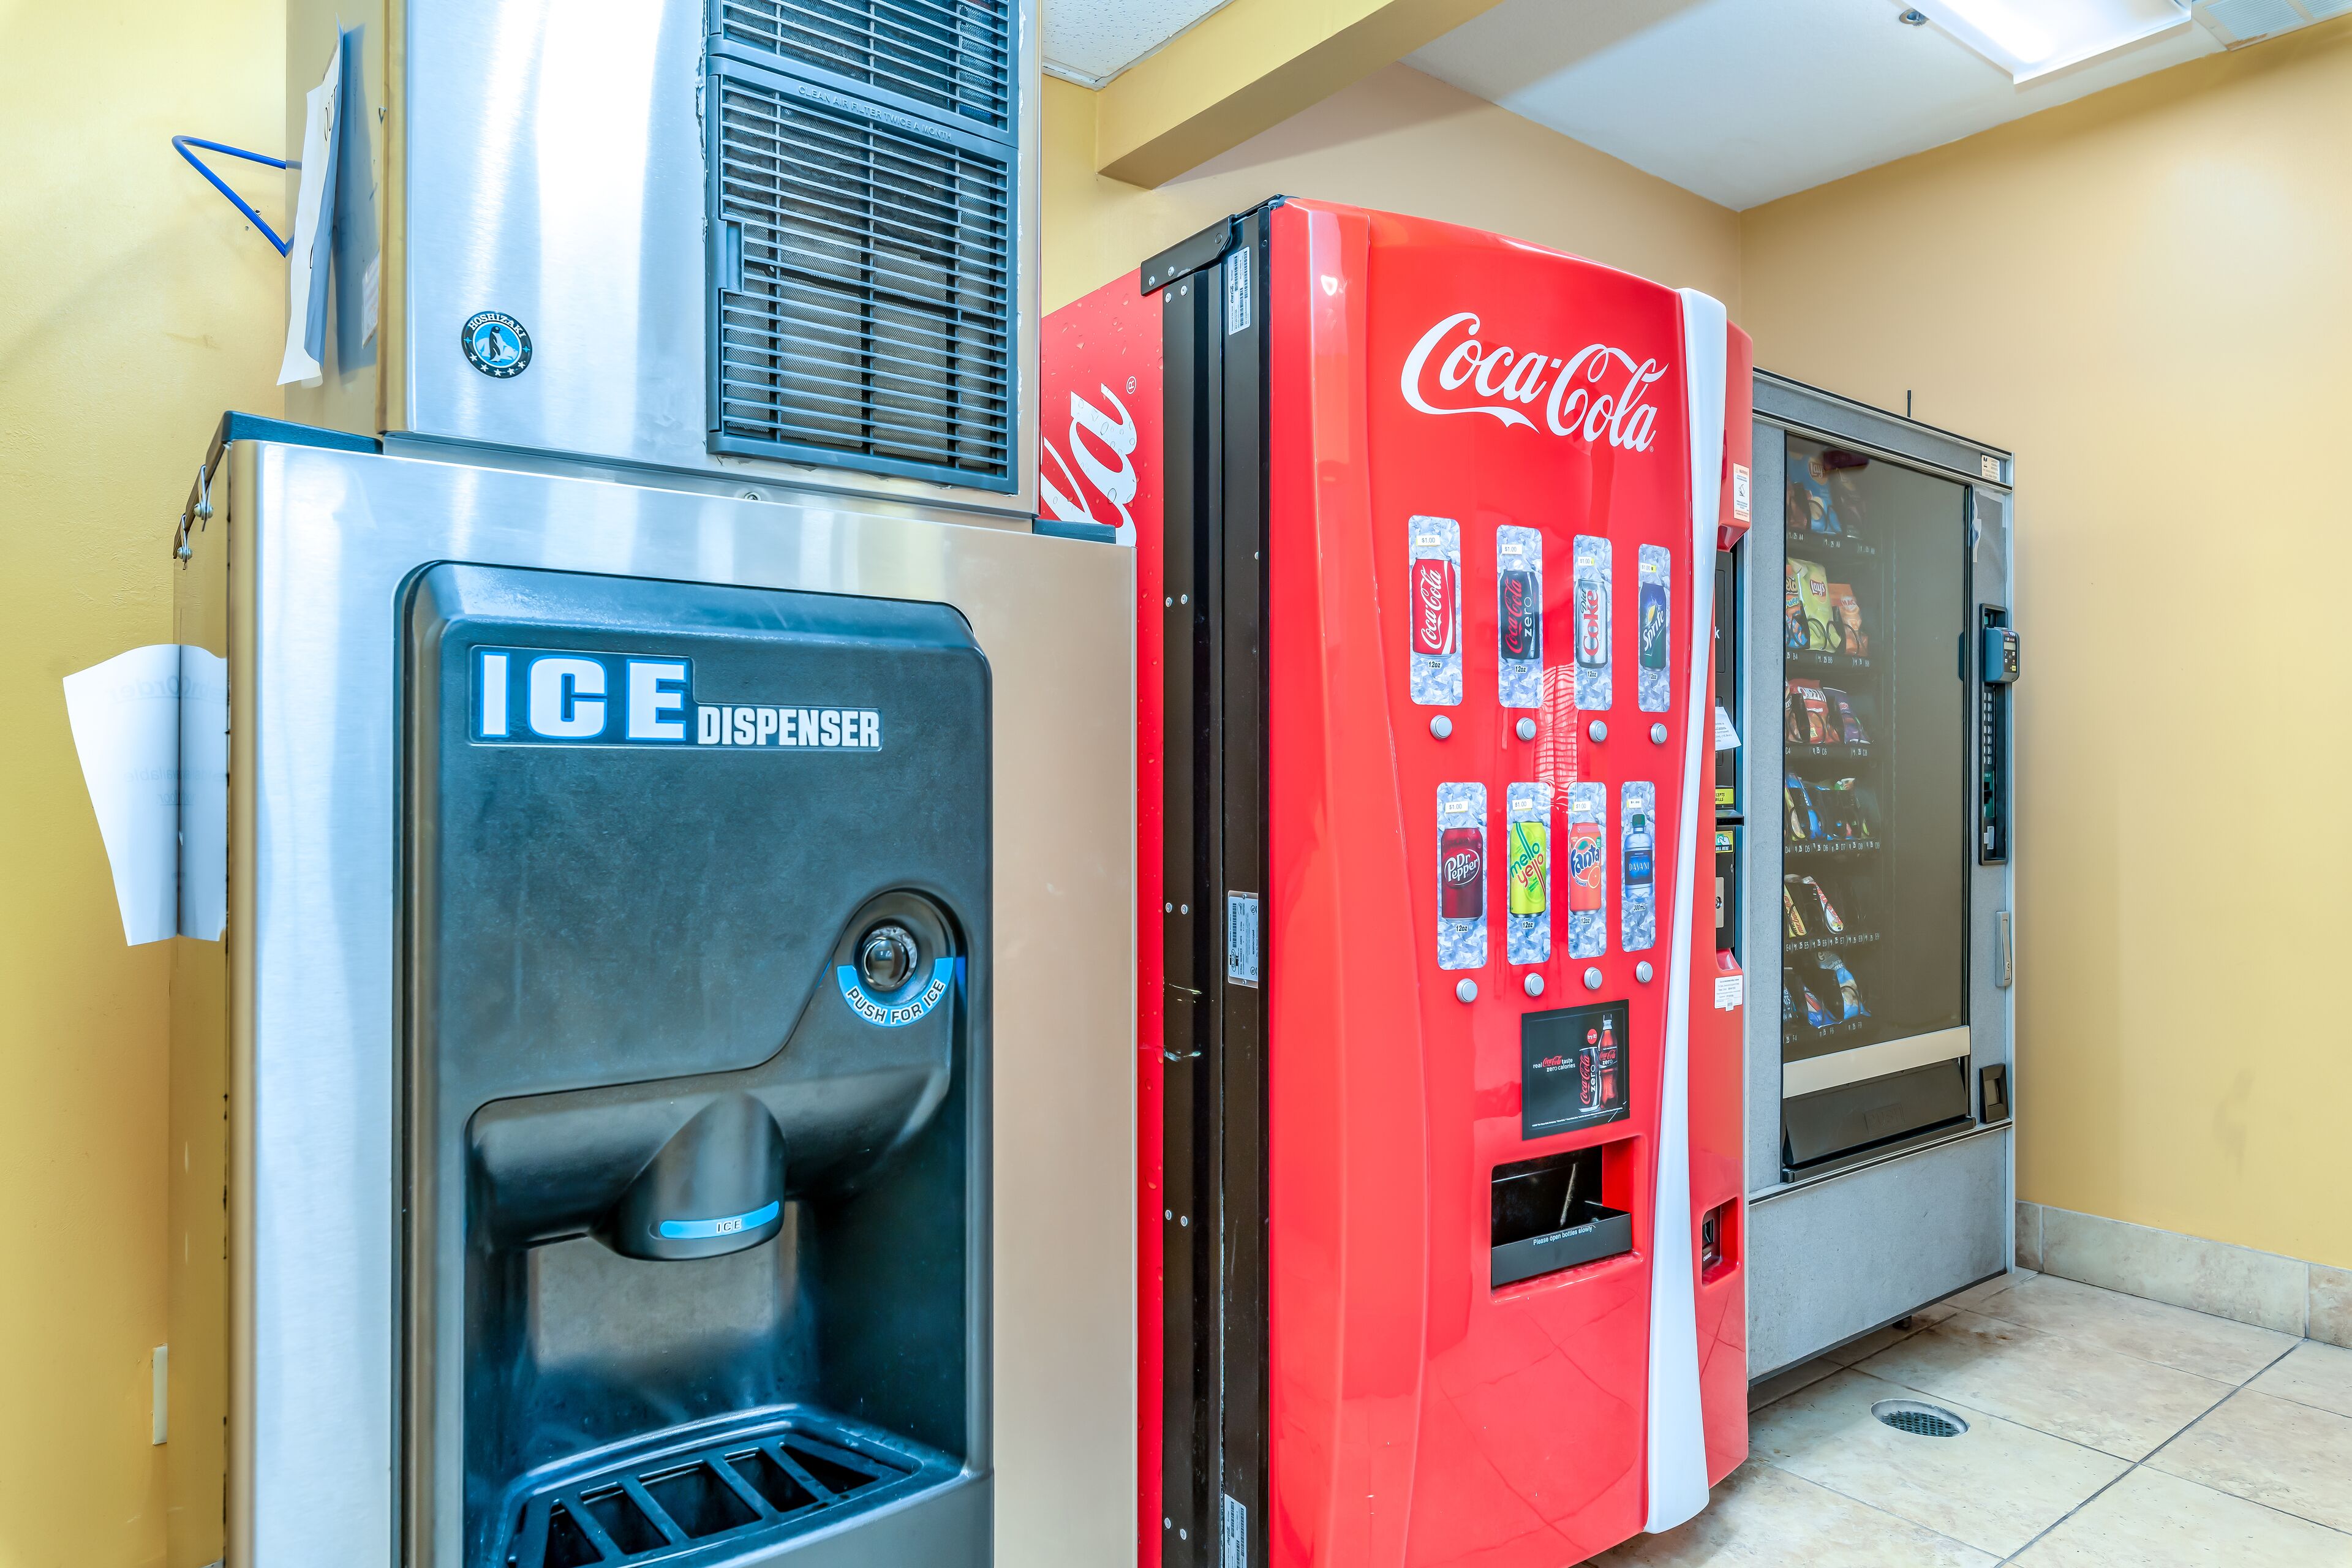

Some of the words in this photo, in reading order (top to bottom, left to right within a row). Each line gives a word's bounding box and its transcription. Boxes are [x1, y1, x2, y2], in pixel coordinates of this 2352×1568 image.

[798, 85, 830, 102] CLEAN
[833, 97, 848, 108] AIR
[851, 102, 882, 118] FILTER
[883, 112, 912, 128] TWICE
[913, 122, 921, 132] A
[922, 125, 951, 141] MONTH
[468, 313, 527, 337] HOSHIZAKI
[1400, 312, 1669, 452] Coca-Cola
[1421, 565, 1442, 649] Coca-Cola
[1505, 575, 1523, 654] Coca-Cola
[1524, 597, 1532, 637] zero
[1583, 590, 1599, 657] Coke
[1643, 609, 1664, 652] Sprite
[481, 651, 687, 741] ICE
[698, 706, 881, 748] DISPENSER
[1448, 858, 1479, 882] Pepper
[1457, 853, 1471, 870] Dr
[1510, 834, 1540, 878] mello
[1517, 853, 1545, 891] yello
[1570, 844, 1600, 878] Fanta
[1629, 862, 1649, 872] DASANI
[847, 987, 886, 1022] PUSH
[892, 1004, 922, 1023] FOR
[924, 981, 944, 1006] ICE
[1543, 1055, 1562, 1067] Coca-Cola
[1599, 1049, 1616, 1060] Coca-Cola
[1580, 1054, 1590, 1104] Coca-Cola
[717, 1219, 741, 1232] ICE
[1533, 1237, 1549, 1246] Please
[1562, 1230, 1578, 1238] bottles
[1578, 1226, 1593, 1234] slowly
